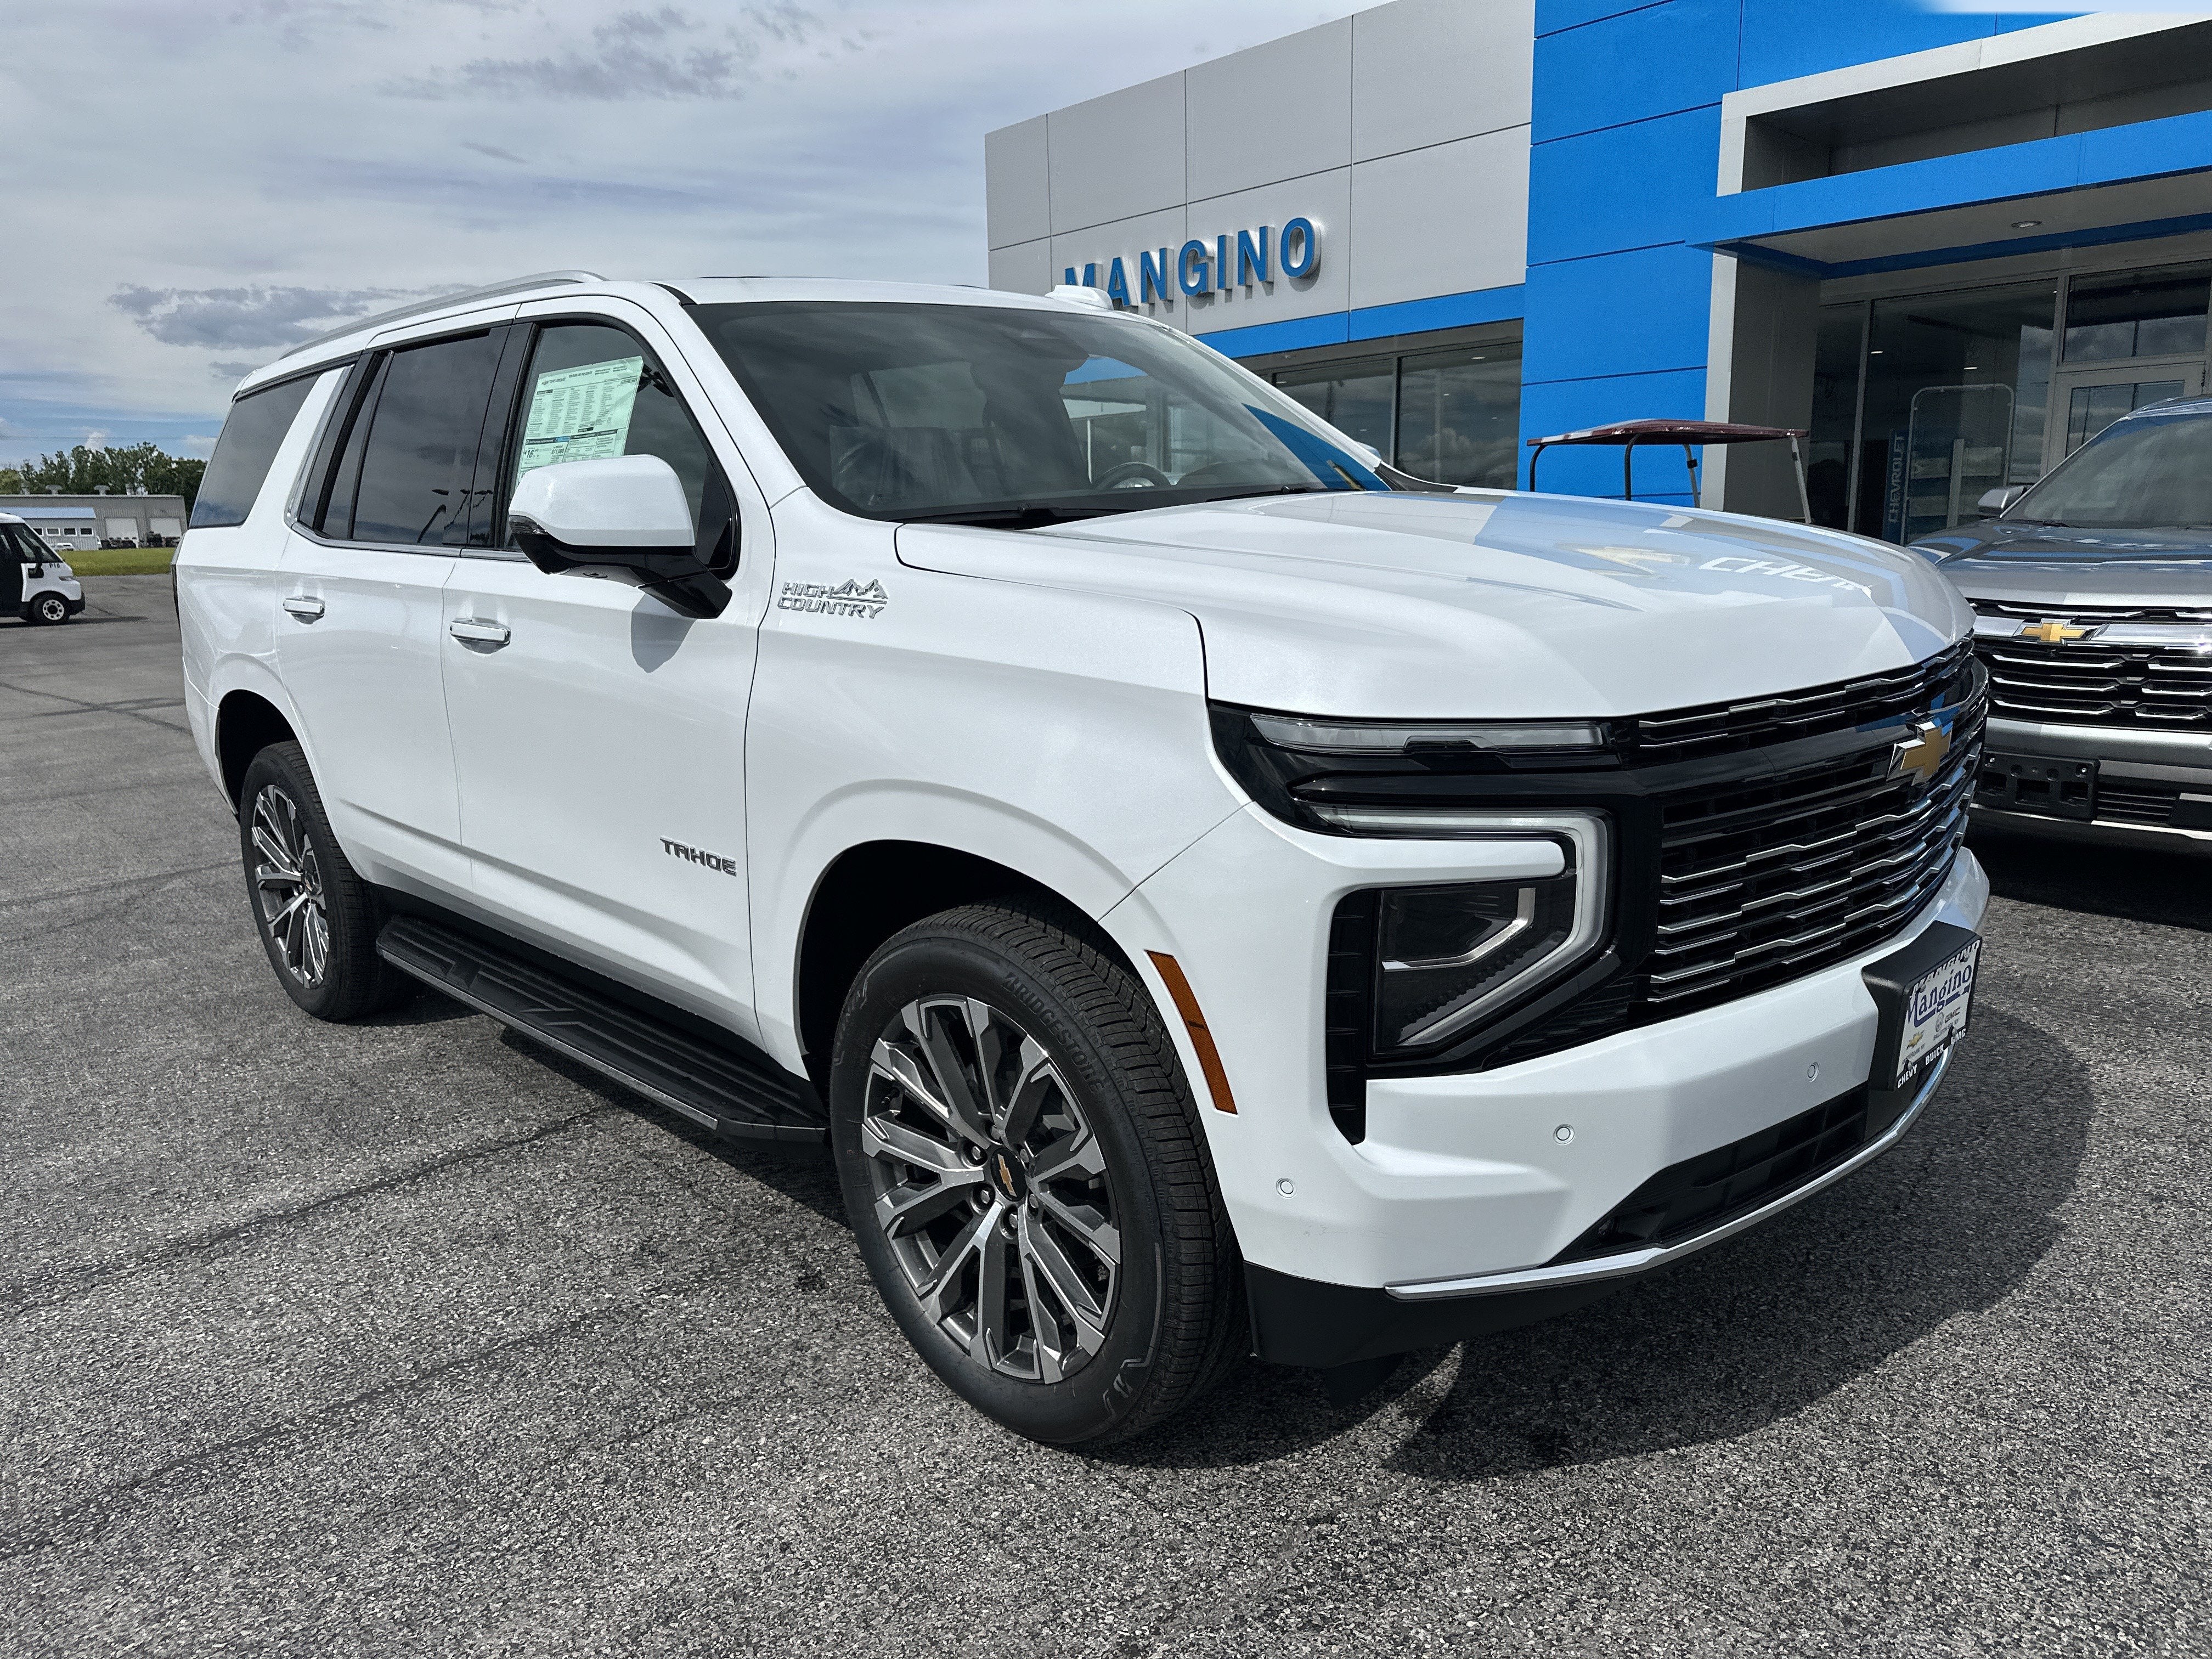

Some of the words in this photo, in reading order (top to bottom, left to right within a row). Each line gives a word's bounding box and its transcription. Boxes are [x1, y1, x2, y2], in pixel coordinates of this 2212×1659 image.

[1888, 435, 1904, 523] CHEVROLET
[782, 582, 835, 598] HIGH
[777, 596, 884, 619] COUNTRY
[660, 837, 737, 877] TAHOE
[1945, 1007, 1961, 1024] GMC
[1002, 972, 1105, 1094] BRIDGESTONE
[1951, 1028, 1966, 1045] GMC
[1925, 1043, 1944, 1065] BUICK
[1898, 1064, 1917, 1089] CHEVY
